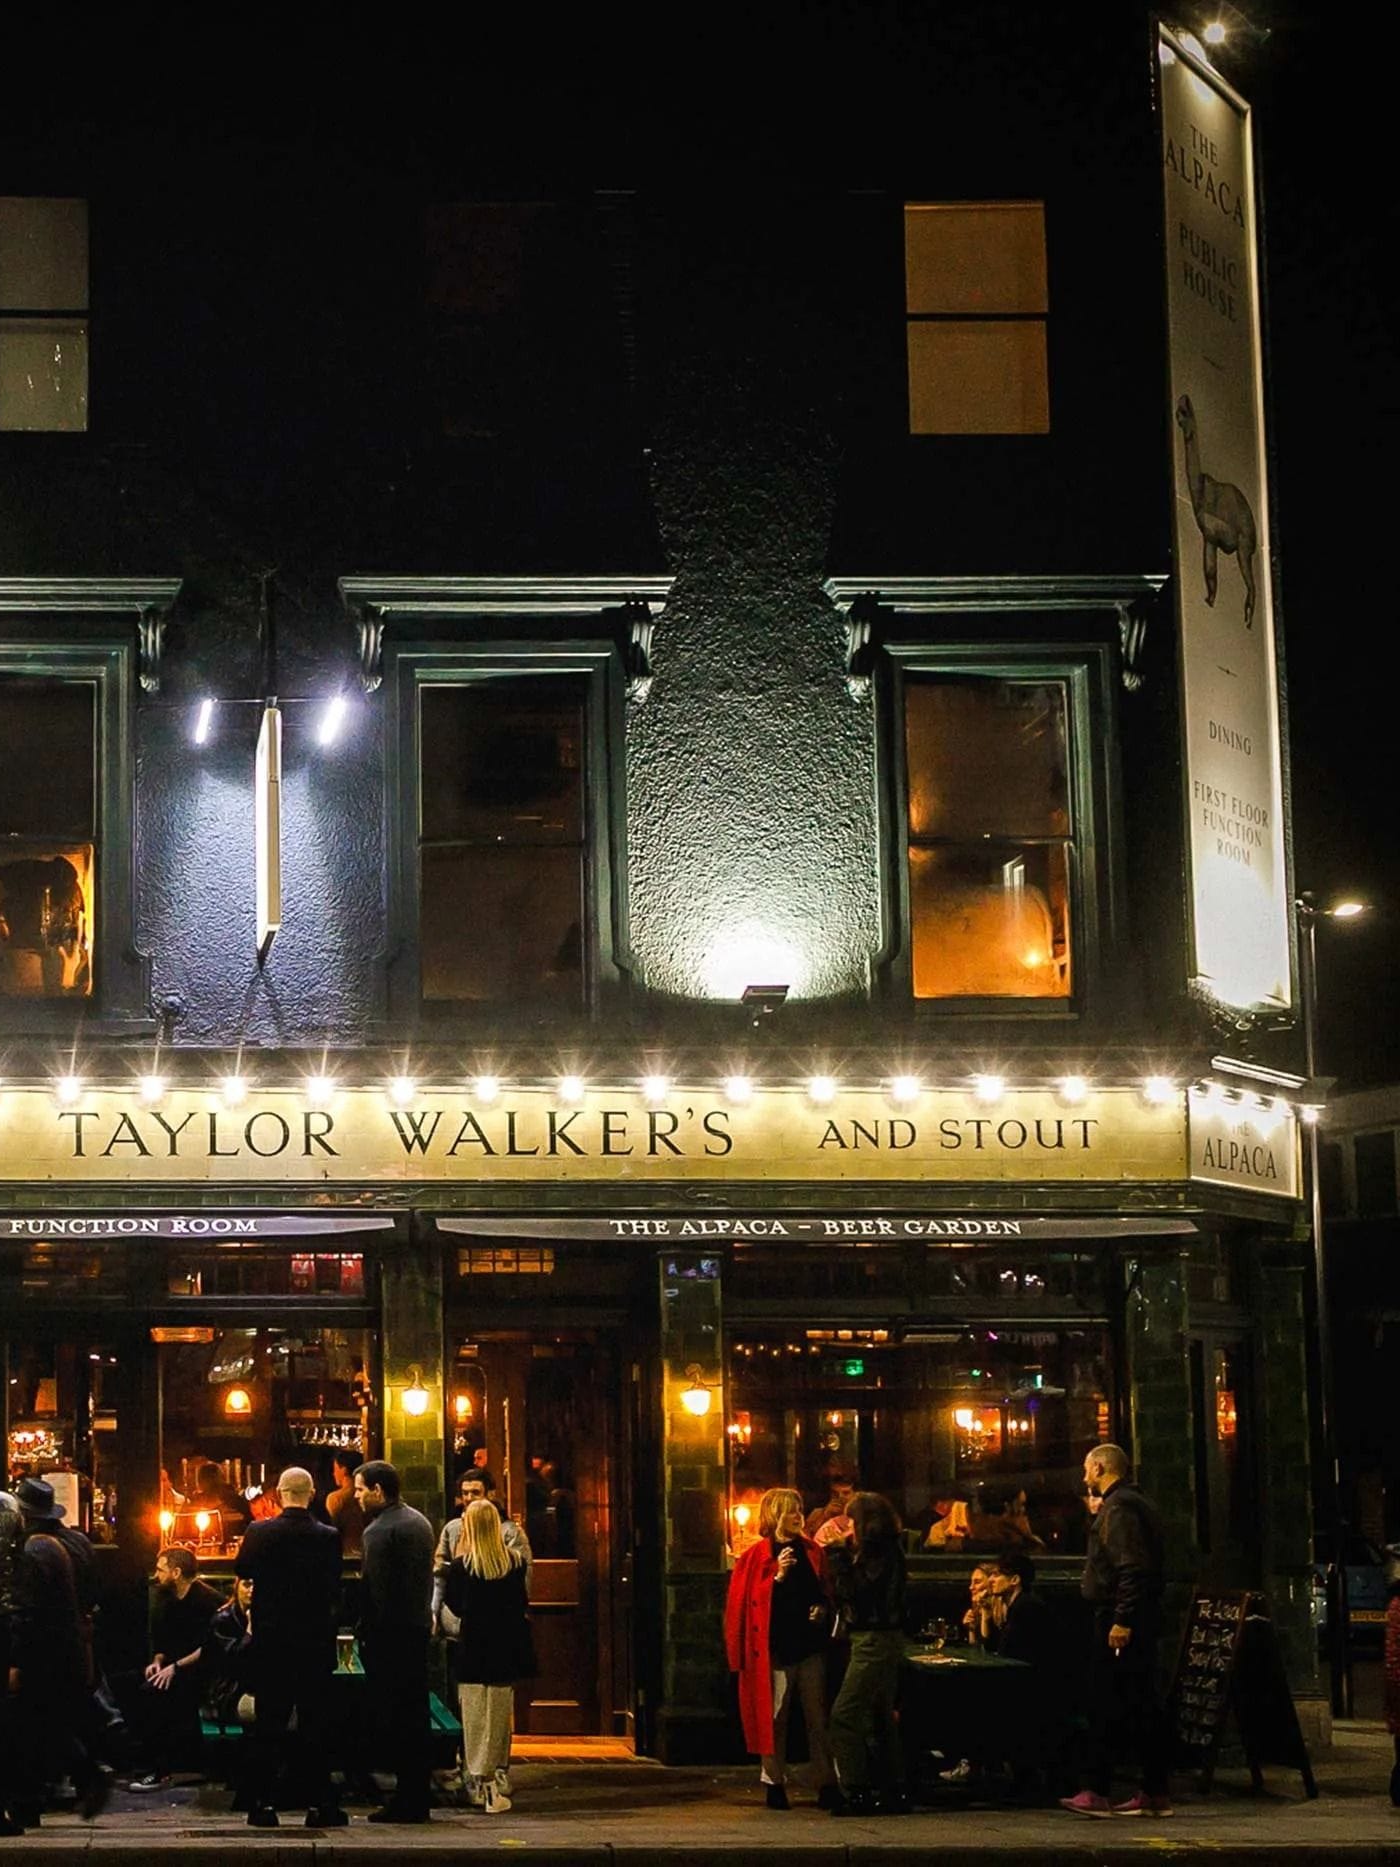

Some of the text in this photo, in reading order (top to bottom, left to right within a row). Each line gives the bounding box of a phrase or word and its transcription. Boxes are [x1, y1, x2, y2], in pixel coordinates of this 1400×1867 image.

[1190, 124, 1218, 167] THE
[1165, 138, 1245, 229] ALPACA
[1179, 222, 1237, 288] PUBLIC
[1183, 262, 1236, 322] HOUSE
[1209, 720, 1251, 756] DINING
[1194, 781, 1268, 829] FIRST FLOOR
[1203, 808, 1261, 847] FUNCTION
[1217, 838, 1250, 866] ROOM
[57, 1107, 734, 1158] TAYLOR WALKER'S
[817, 1119, 1099, 1150] AND STOUT
[1202, 1136, 1277, 1179] ALPACA
[10, 1219, 160, 1234] FUNCTION
[171, 1219, 258, 1234] ROOM
[610, 1220, 670, 1236] THE
[679, 1220, 789, 1235] ALPACA
[823, 1219, 896, 1236] BEER
[904, 1219, 1022, 1235] GARDEN
